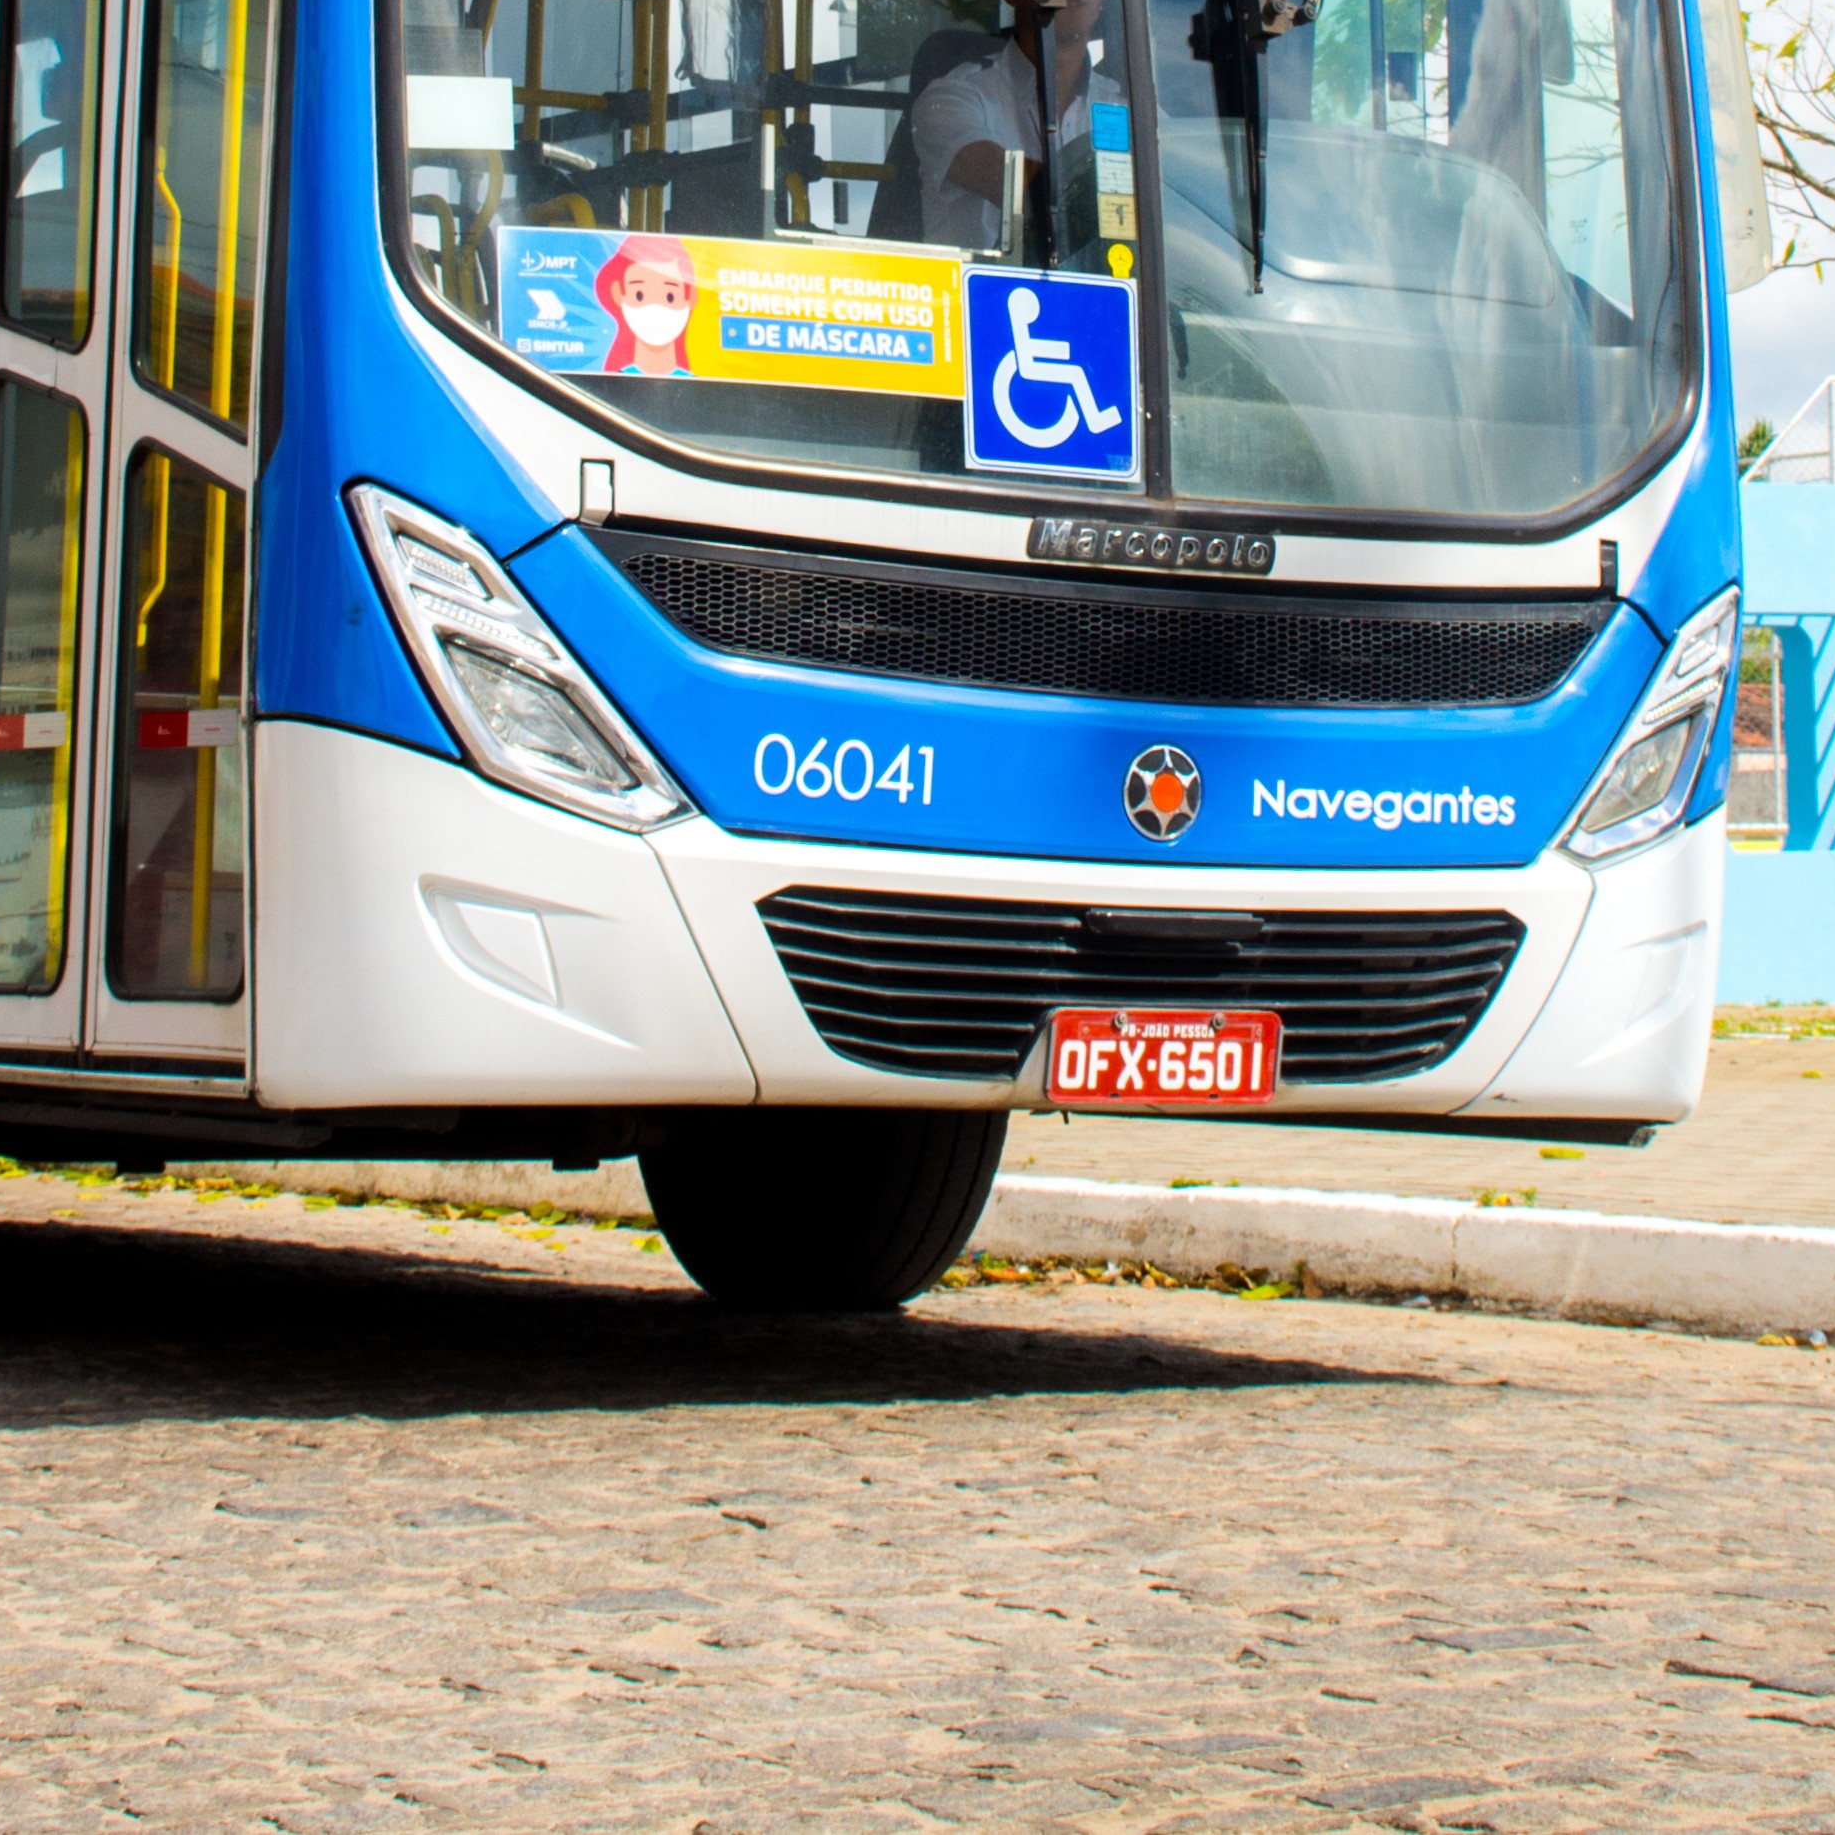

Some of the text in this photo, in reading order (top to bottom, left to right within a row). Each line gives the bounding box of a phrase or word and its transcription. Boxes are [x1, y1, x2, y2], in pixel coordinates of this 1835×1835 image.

[546, 256, 577, 270] MPT
[717, 268, 826, 295] EMBARQUE
[829, 276, 934, 303] PERMITIDO
[718, 291, 934, 328] SOMENTE COM USO
[532, 340, 584, 354] SINTUR
[746, 323, 781, 348] DE
[786, 321, 911, 358] MÁSCARA
[1036, 517, 1270, 568] Marcopolo
[753, 732, 935, 806] 06041
[1252, 778, 1517, 831] Navegantes
[1173, 1023, 1216, 1039] PESSOA
